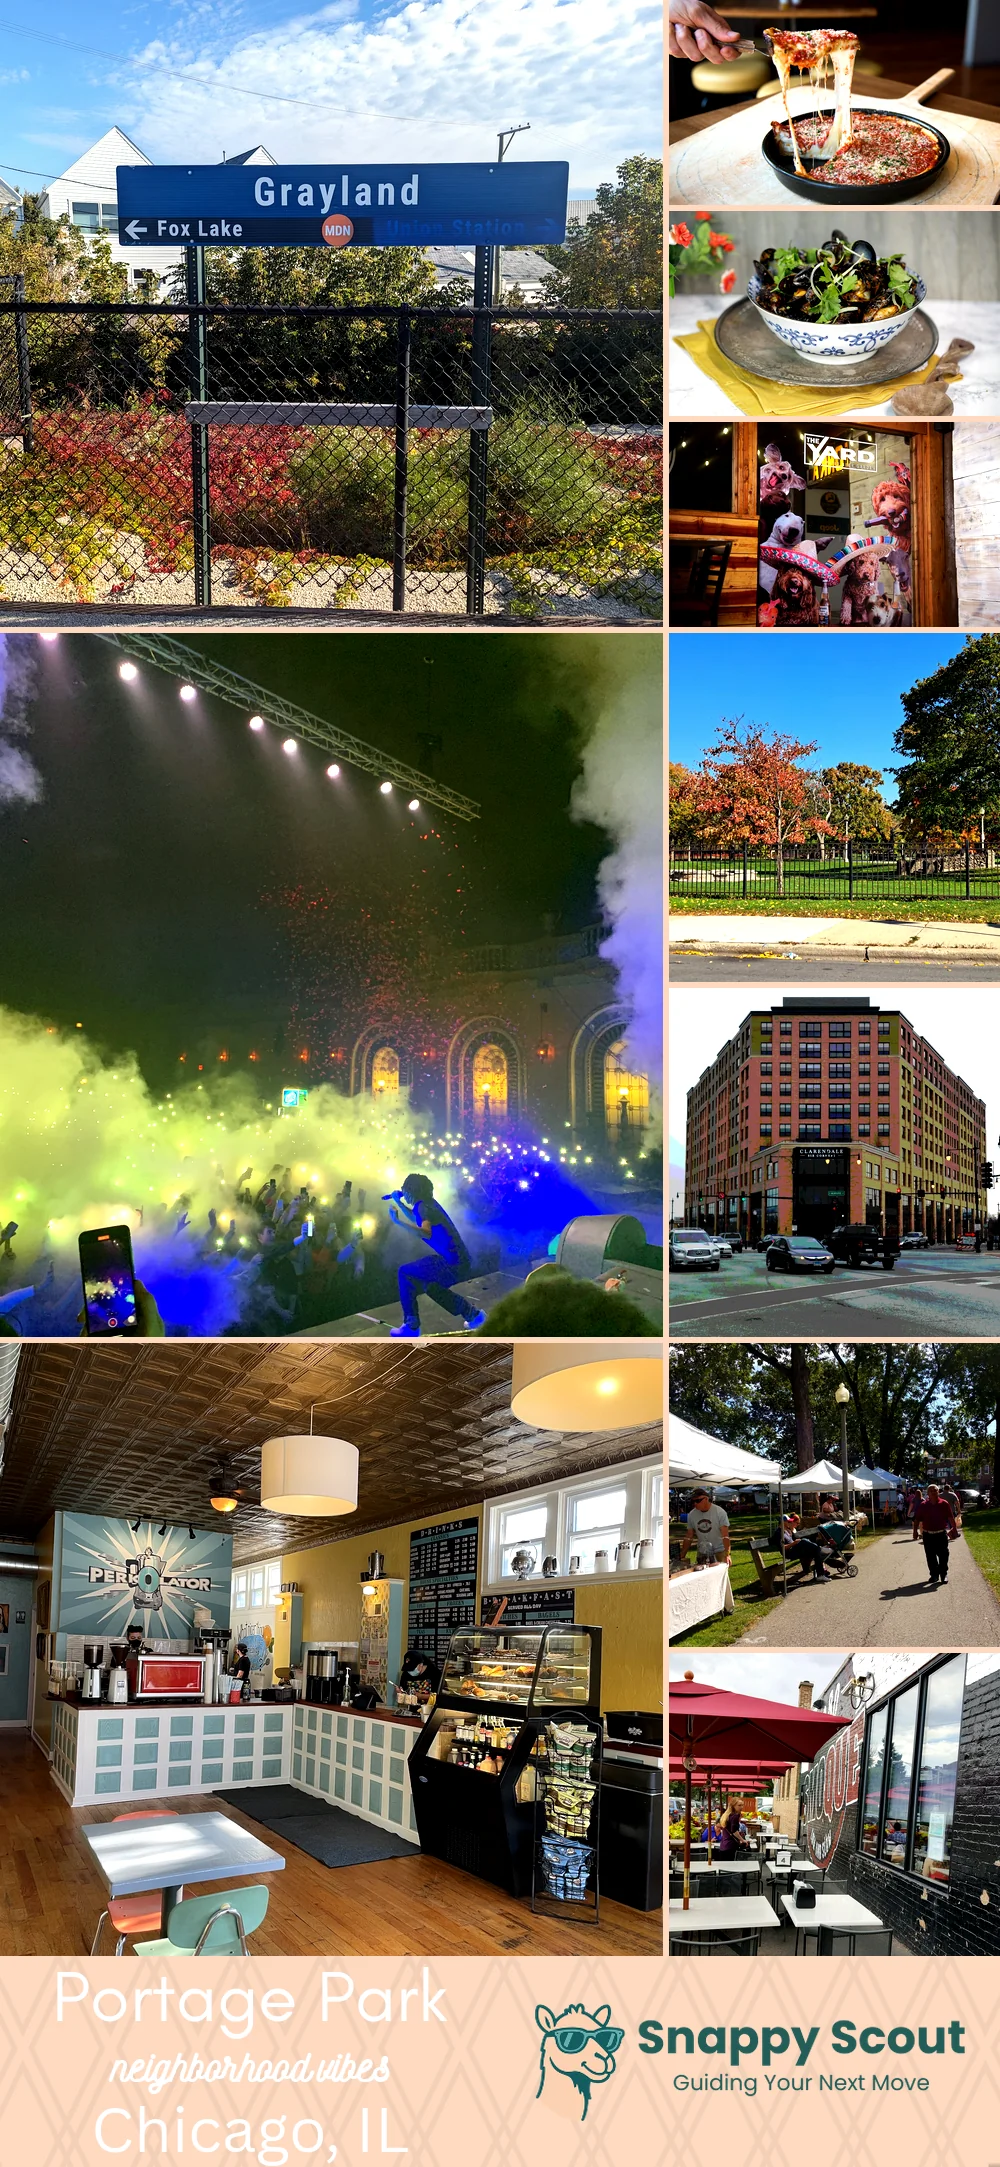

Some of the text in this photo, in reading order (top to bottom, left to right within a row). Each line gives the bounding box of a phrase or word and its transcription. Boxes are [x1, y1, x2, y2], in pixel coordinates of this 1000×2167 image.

[254, 174, 420, 214] Grayland
[157, 220, 243, 237] Fox Lake
[325, 225, 351, 237] MDN
[387, 218, 525, 237] Union Station
[806, 436, 820, 444] THE
[806, 436, 875, 466] YARD
[90, 1566, 211, 1593] PERKOLATOR
